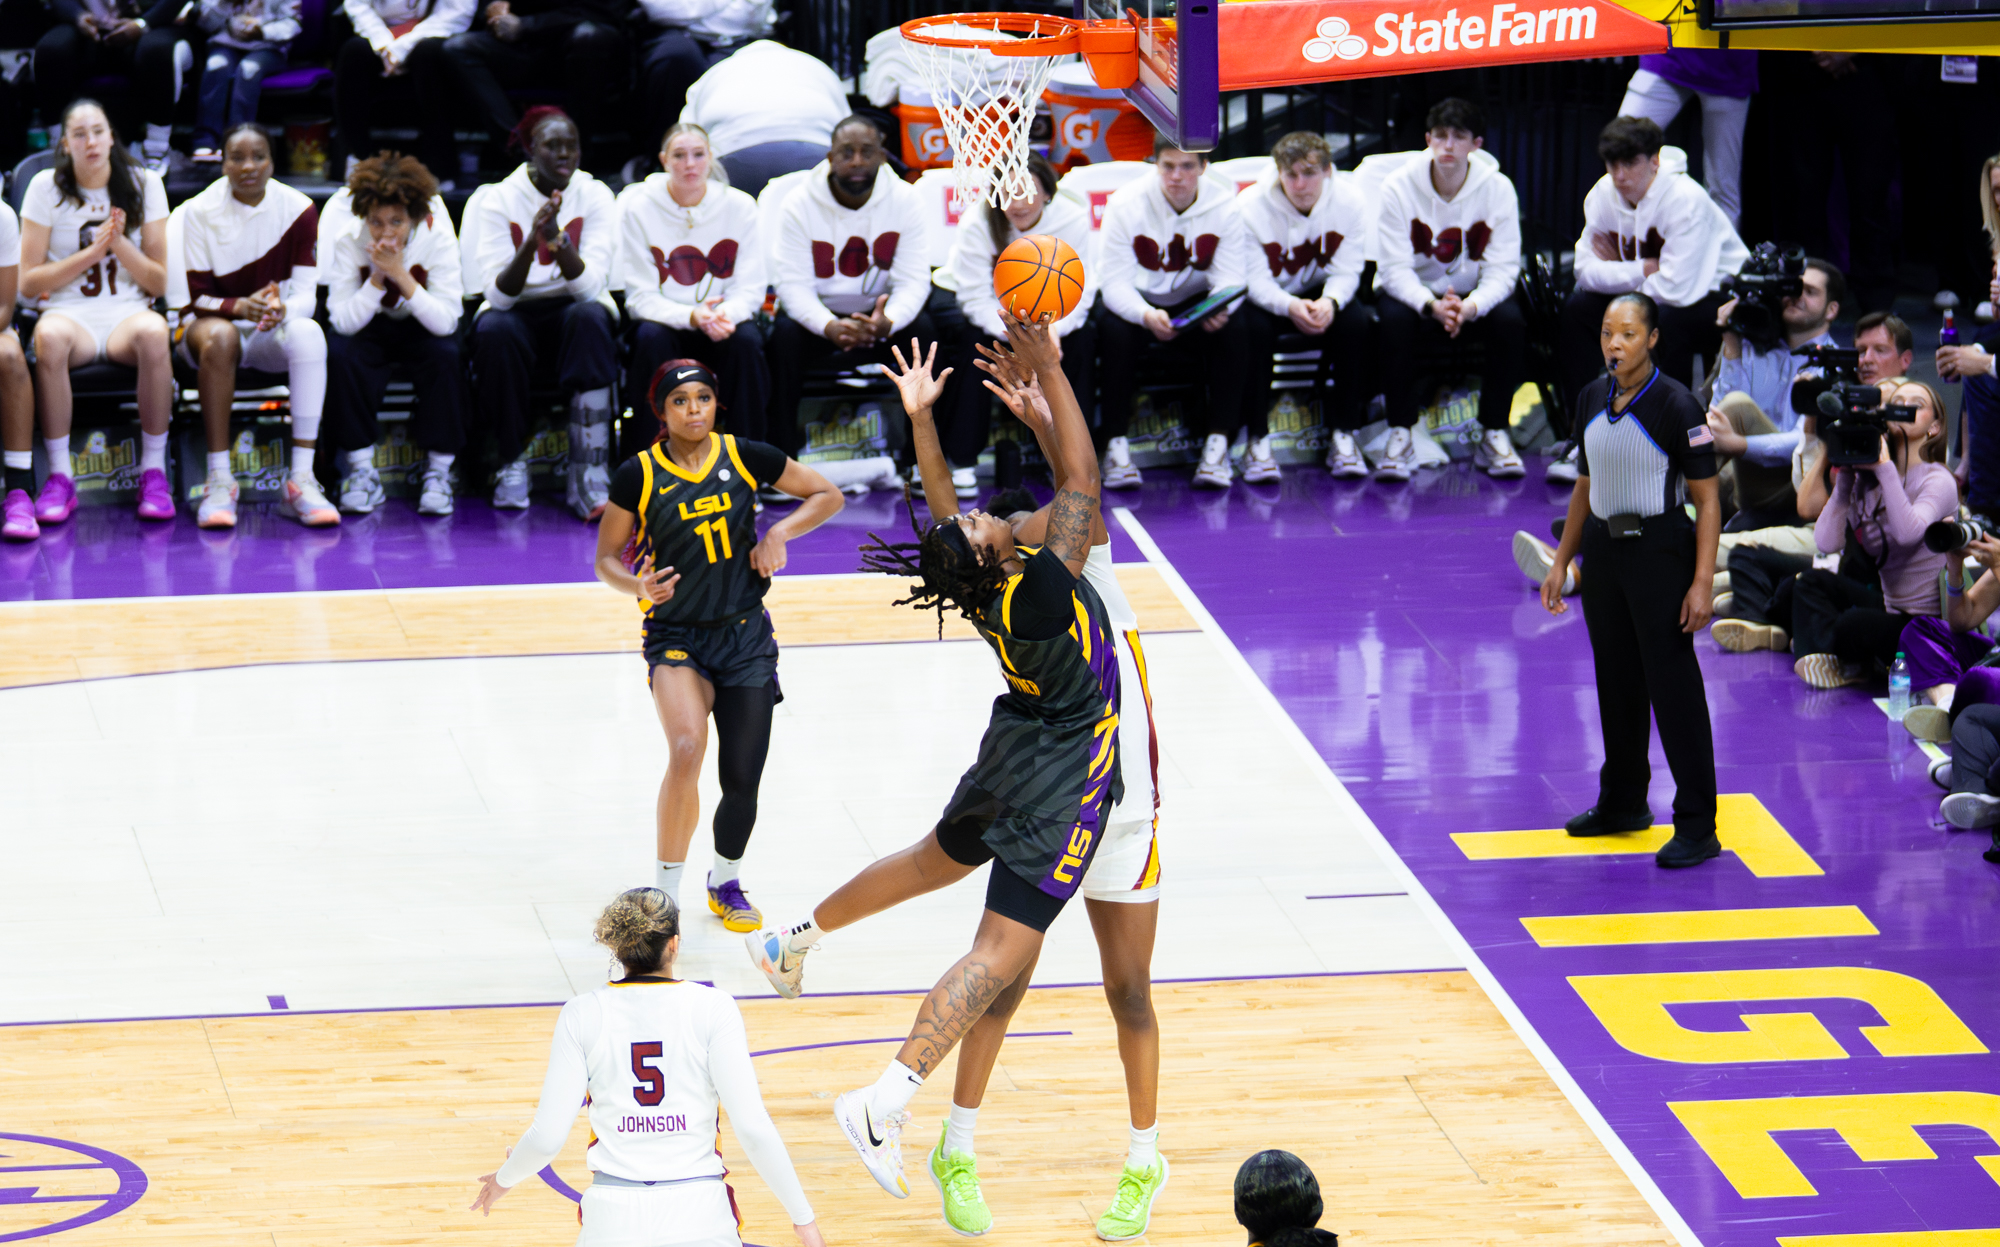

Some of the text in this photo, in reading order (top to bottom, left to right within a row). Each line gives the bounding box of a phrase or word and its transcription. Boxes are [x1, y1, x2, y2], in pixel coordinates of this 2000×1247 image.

[1064, 113, 1093, 149] G
[678, 492, 732, 520] LSU
[694, 516, 733, 564] 11
[1053, 821, 1093, 884] SU
[919, 1005, 975, 1064] FAITH
[1449, 792, 2000, 1247] TIGE
[631, 1041, 665, 1107] 5
[617, 1114, 686, 1133] JOHNSON
